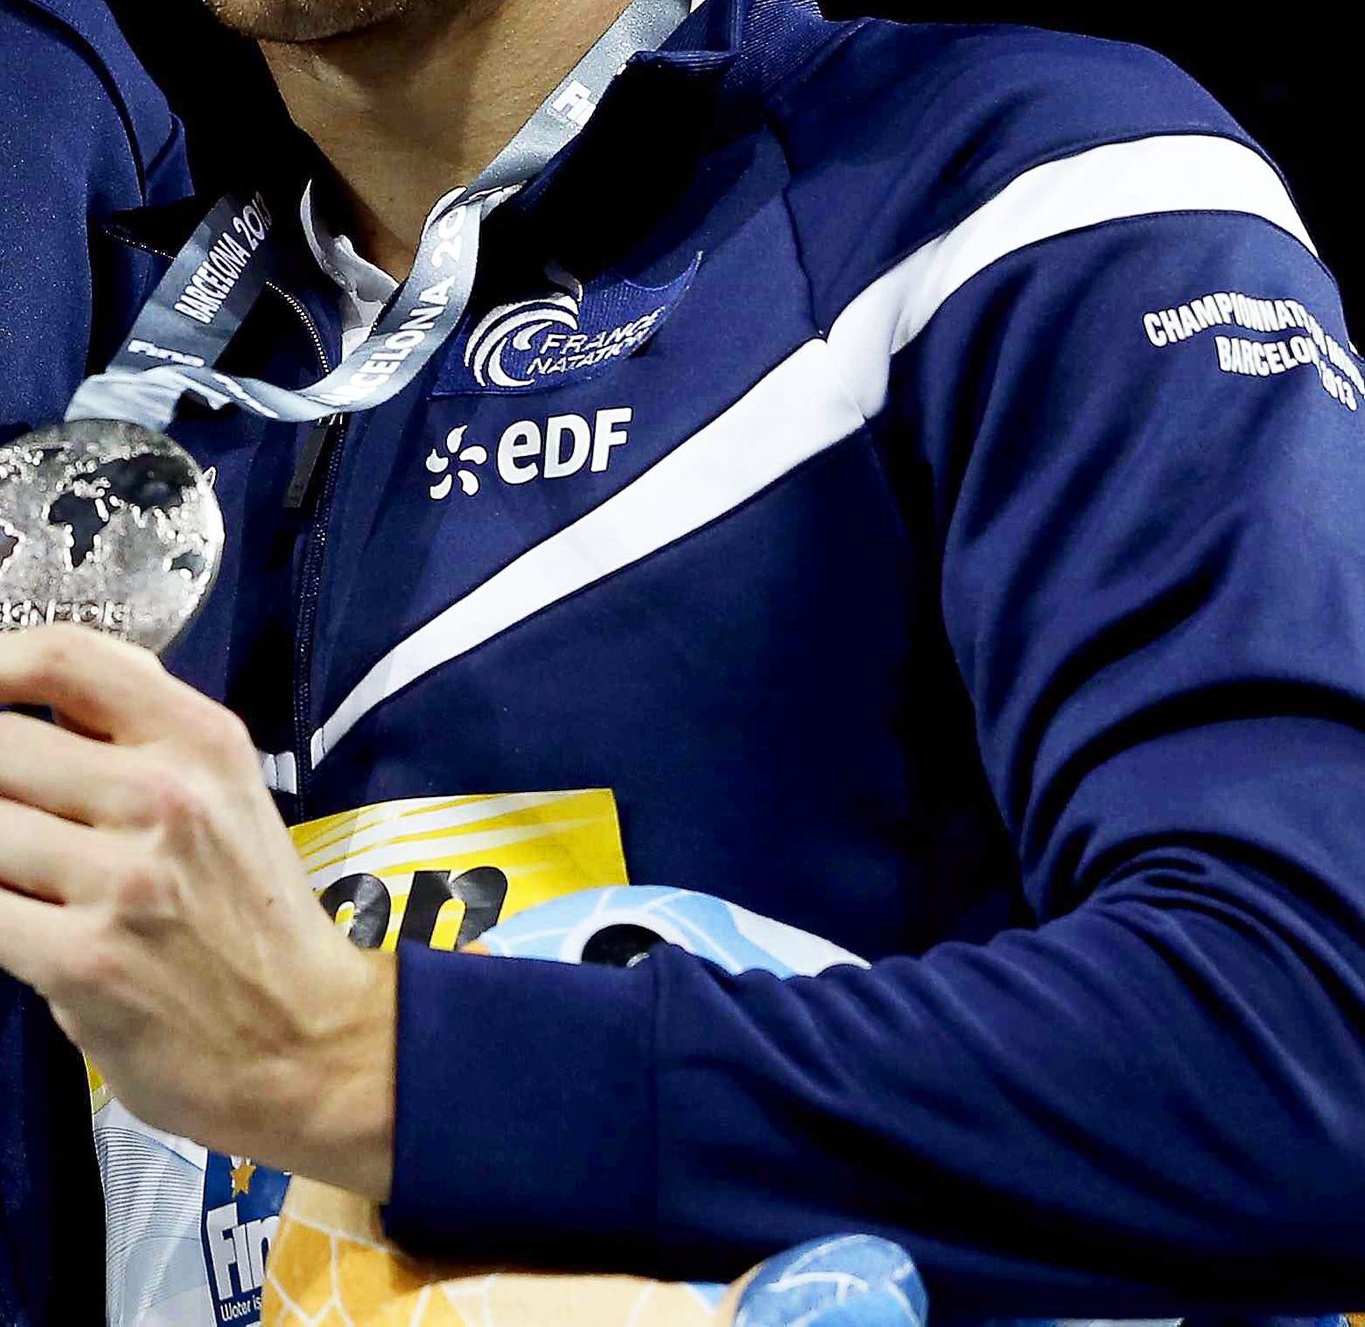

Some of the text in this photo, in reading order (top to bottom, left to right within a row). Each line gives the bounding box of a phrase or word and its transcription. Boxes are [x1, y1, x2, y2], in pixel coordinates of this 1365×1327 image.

[173, 231, 252, 325] BARCELONA
[496, 407, 633, 485] eDF
[206, 1201, 281, 1302] Fin
[220, 1299, 252, 1322] Water
